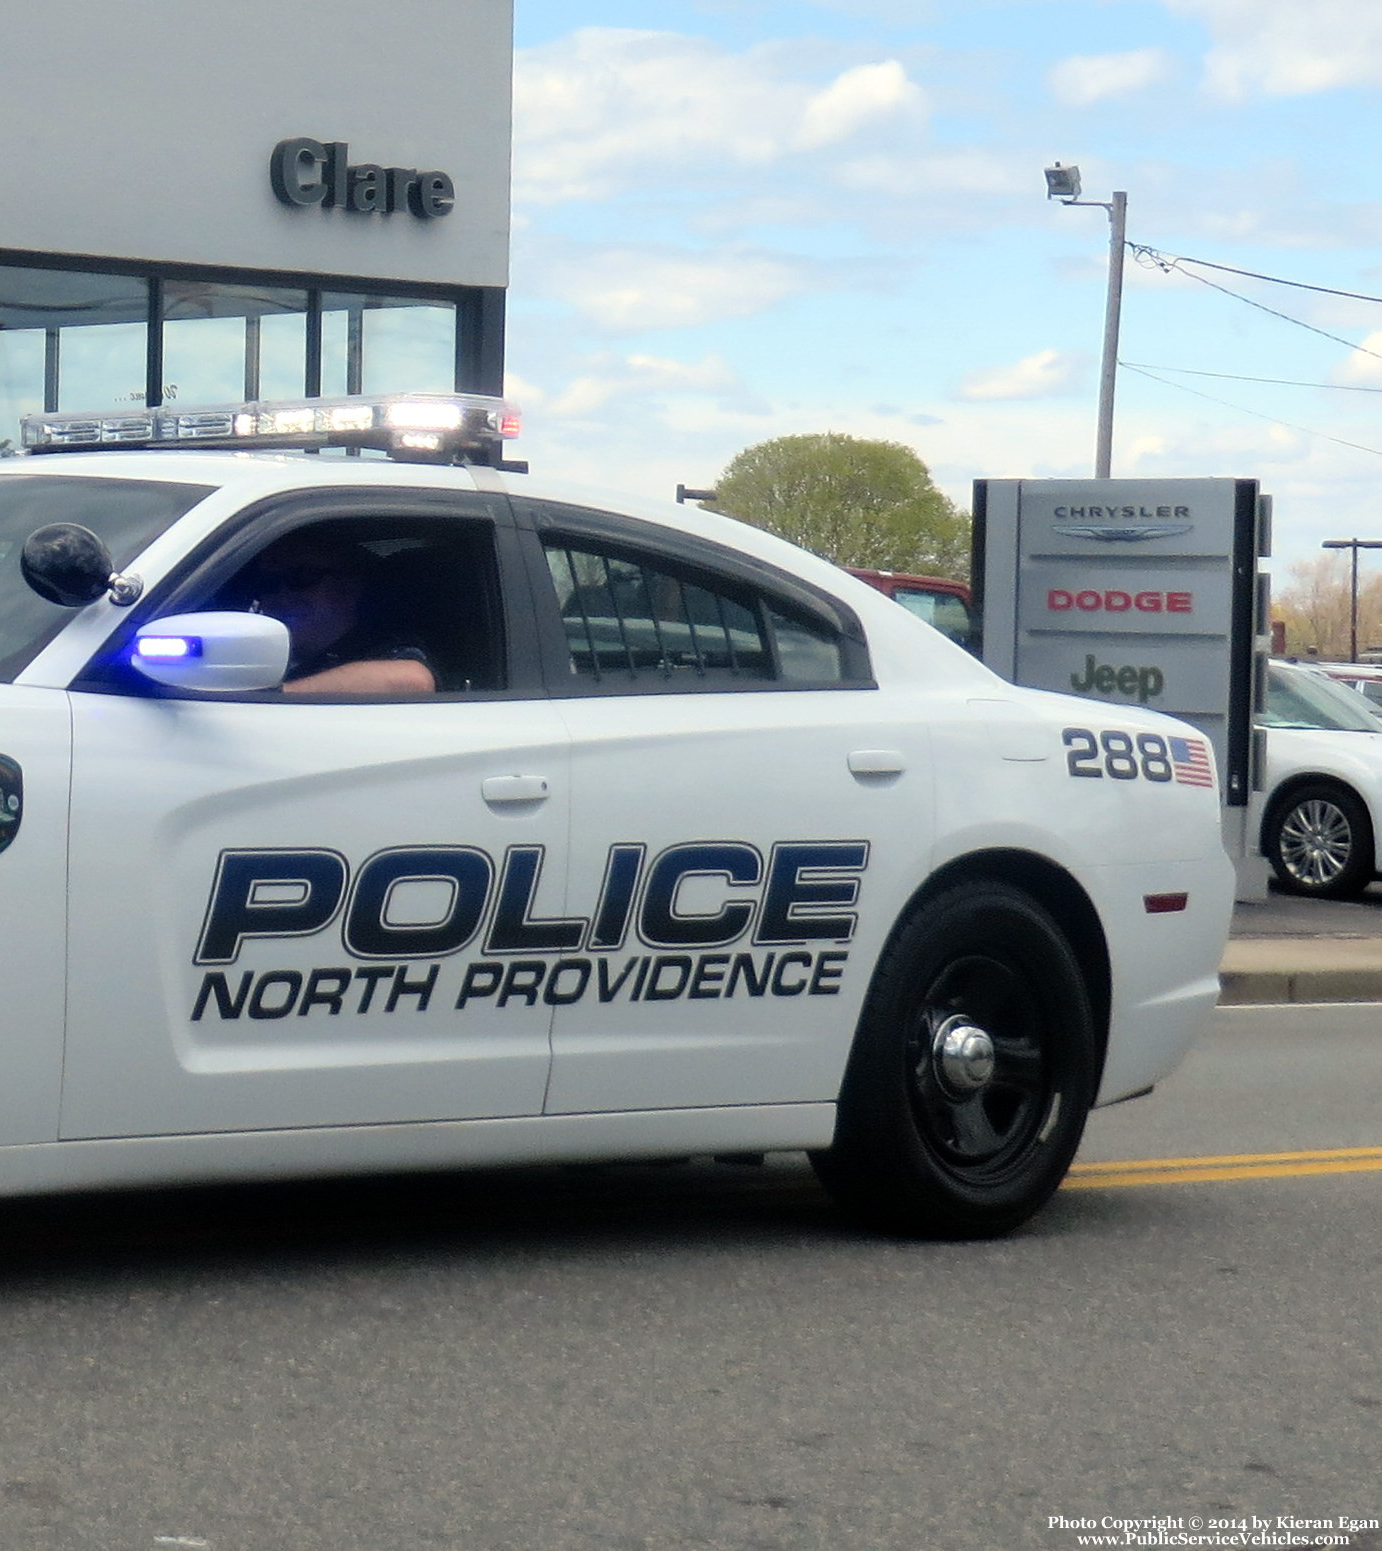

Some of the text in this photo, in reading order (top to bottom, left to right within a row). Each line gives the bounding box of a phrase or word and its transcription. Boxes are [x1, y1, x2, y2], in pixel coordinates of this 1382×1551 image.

[271, 137, 455, 217] Clare
[1054, 506, 1189, 518] CHRYSLER
[1047, 589, 1193, 613] DODGE
[1071, 654, 1164, 703] Jeep
[1062, 727, 1172, 783] 288
[192, 839, 870, 966] POLICE
[190, 951, 849, 1021] NORTH PROVIDENCE
